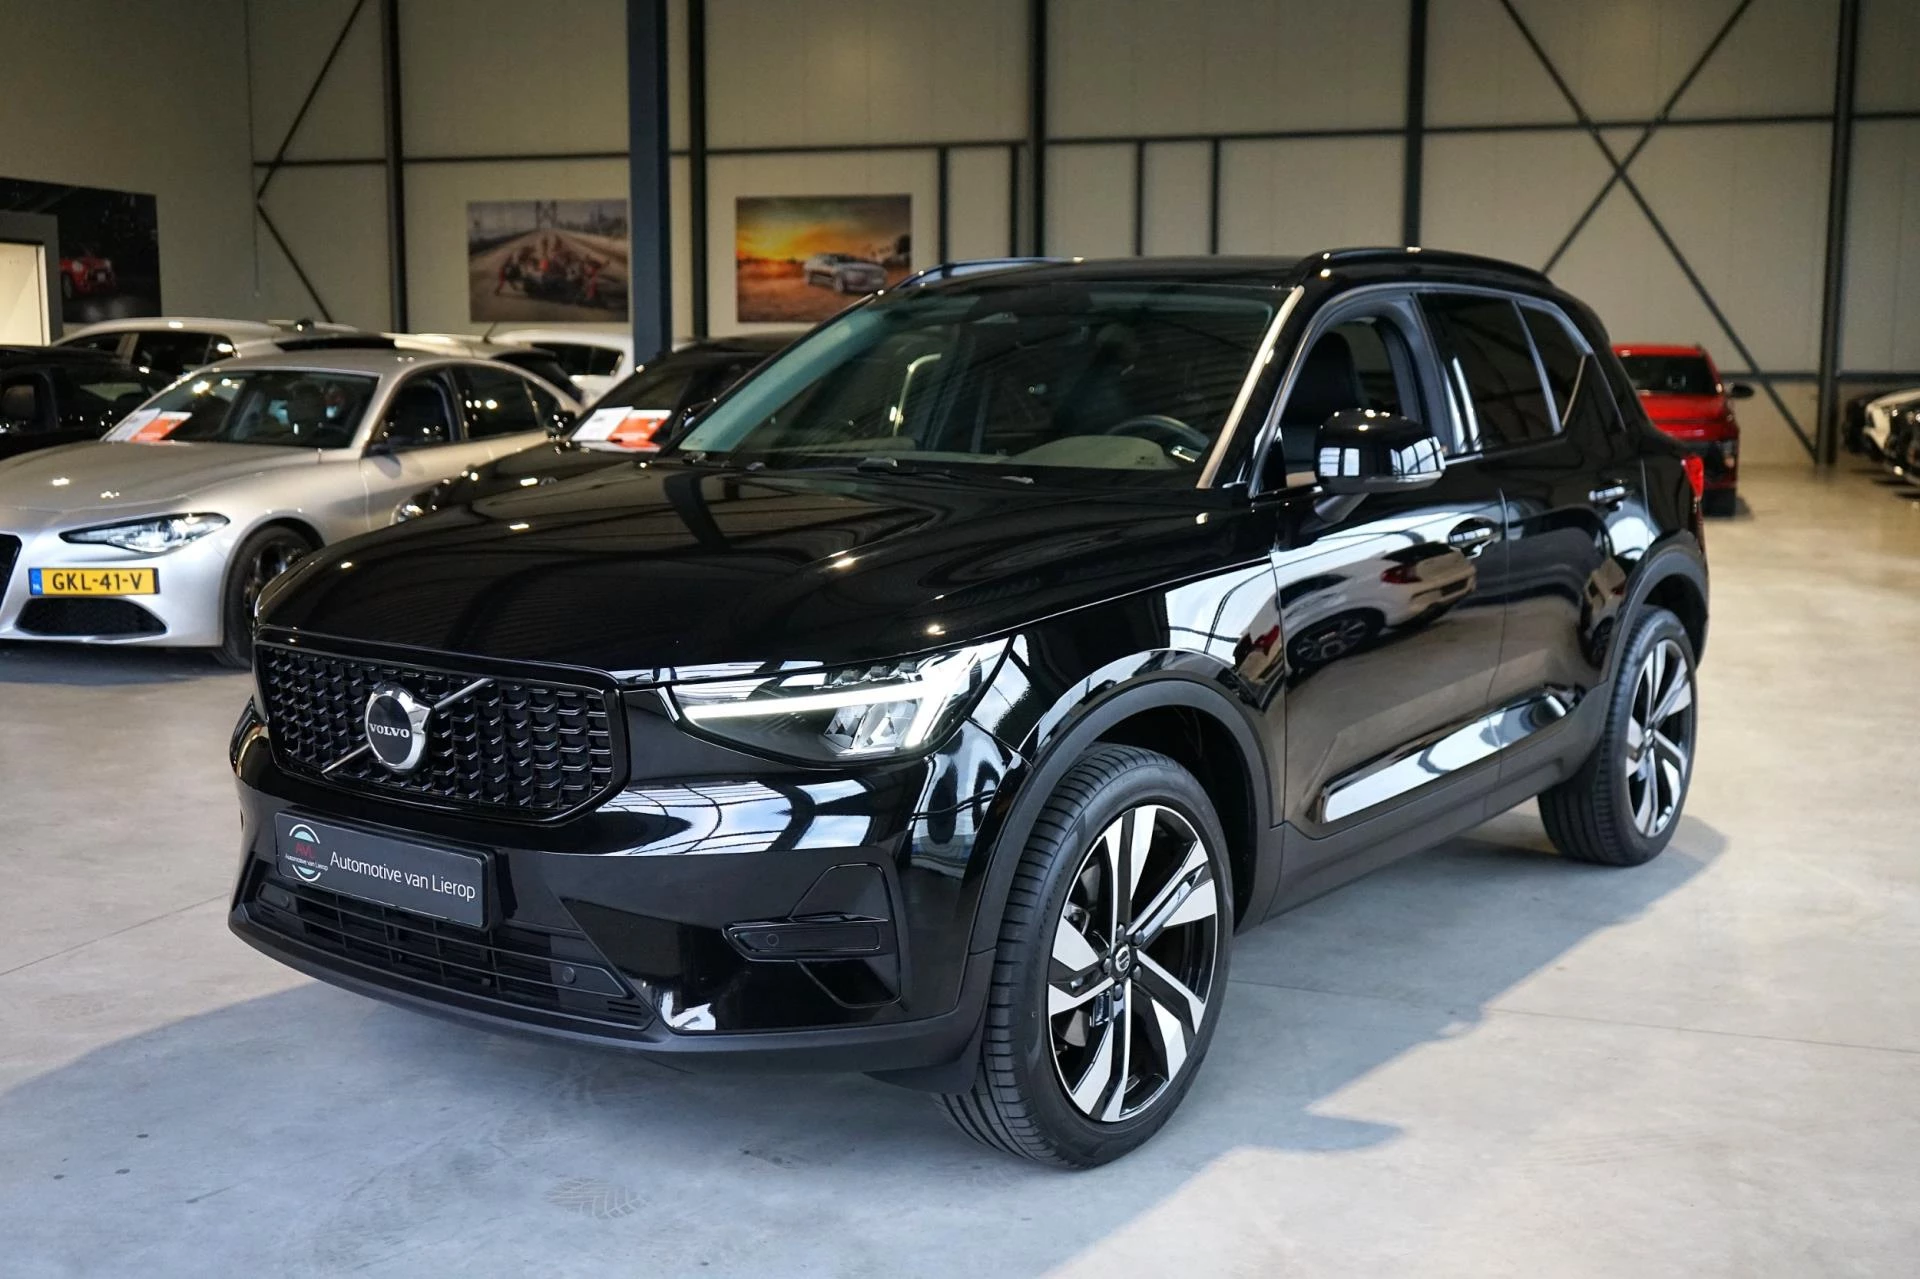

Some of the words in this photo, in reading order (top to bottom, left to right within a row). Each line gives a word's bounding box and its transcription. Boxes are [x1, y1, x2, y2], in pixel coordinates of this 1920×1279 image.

[52, 572, 142, 591] GKL-41-V
[369, 723, 410, 738] VOLVO
[330, 852, 402, 883] Automotive
[404, 873, 428, 889] van
[432, 874, 475, 903] Lierop
